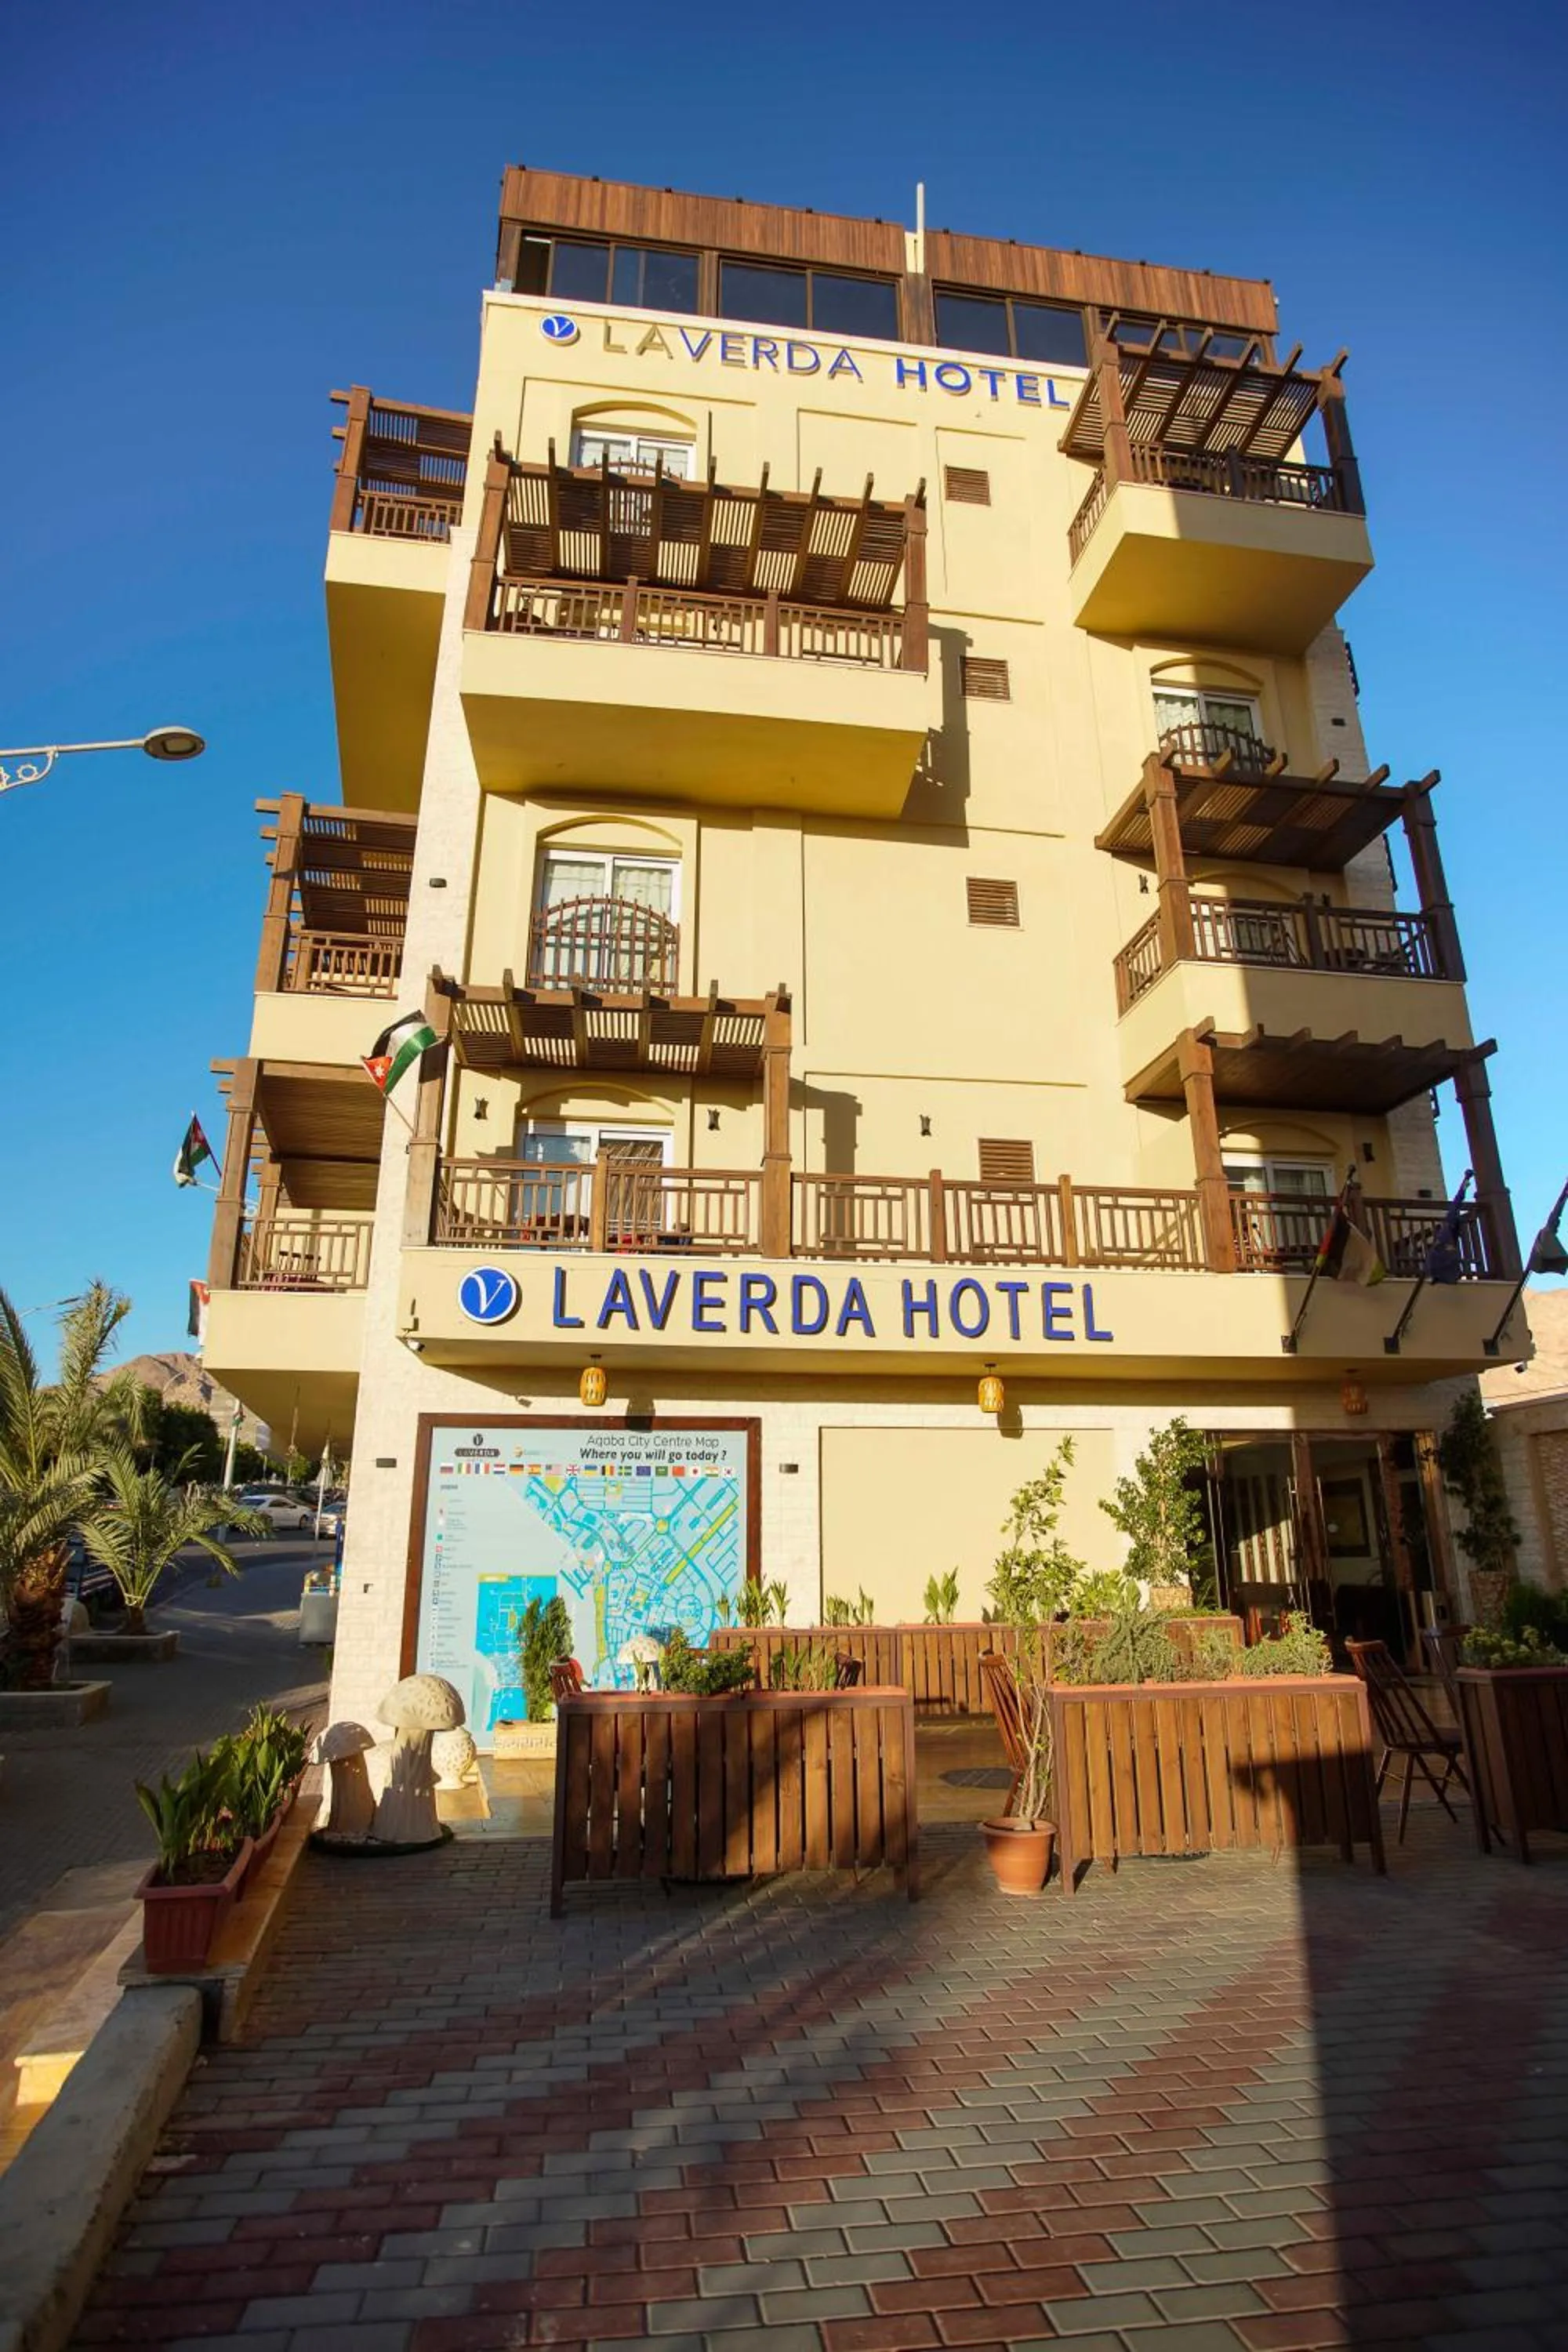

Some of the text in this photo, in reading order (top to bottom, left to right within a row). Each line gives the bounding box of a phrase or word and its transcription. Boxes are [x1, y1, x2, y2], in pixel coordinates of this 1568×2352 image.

[603, 318, 863, 383] LAVERDA
[895, 357, 1071, 411] HOTEL
[552, 1265, 876, 1338] LAVERDA
[902, 1277, 1114, 1341] HOTEL
[579, 1448, 617, 1459] Where
[621, 1450, 642, 1464] you
[645, 1449, 666, 1460] will
[668, 1451, 682, 1464] go
[587, 1436, 719, 1449] Aqaba City Centre Map
